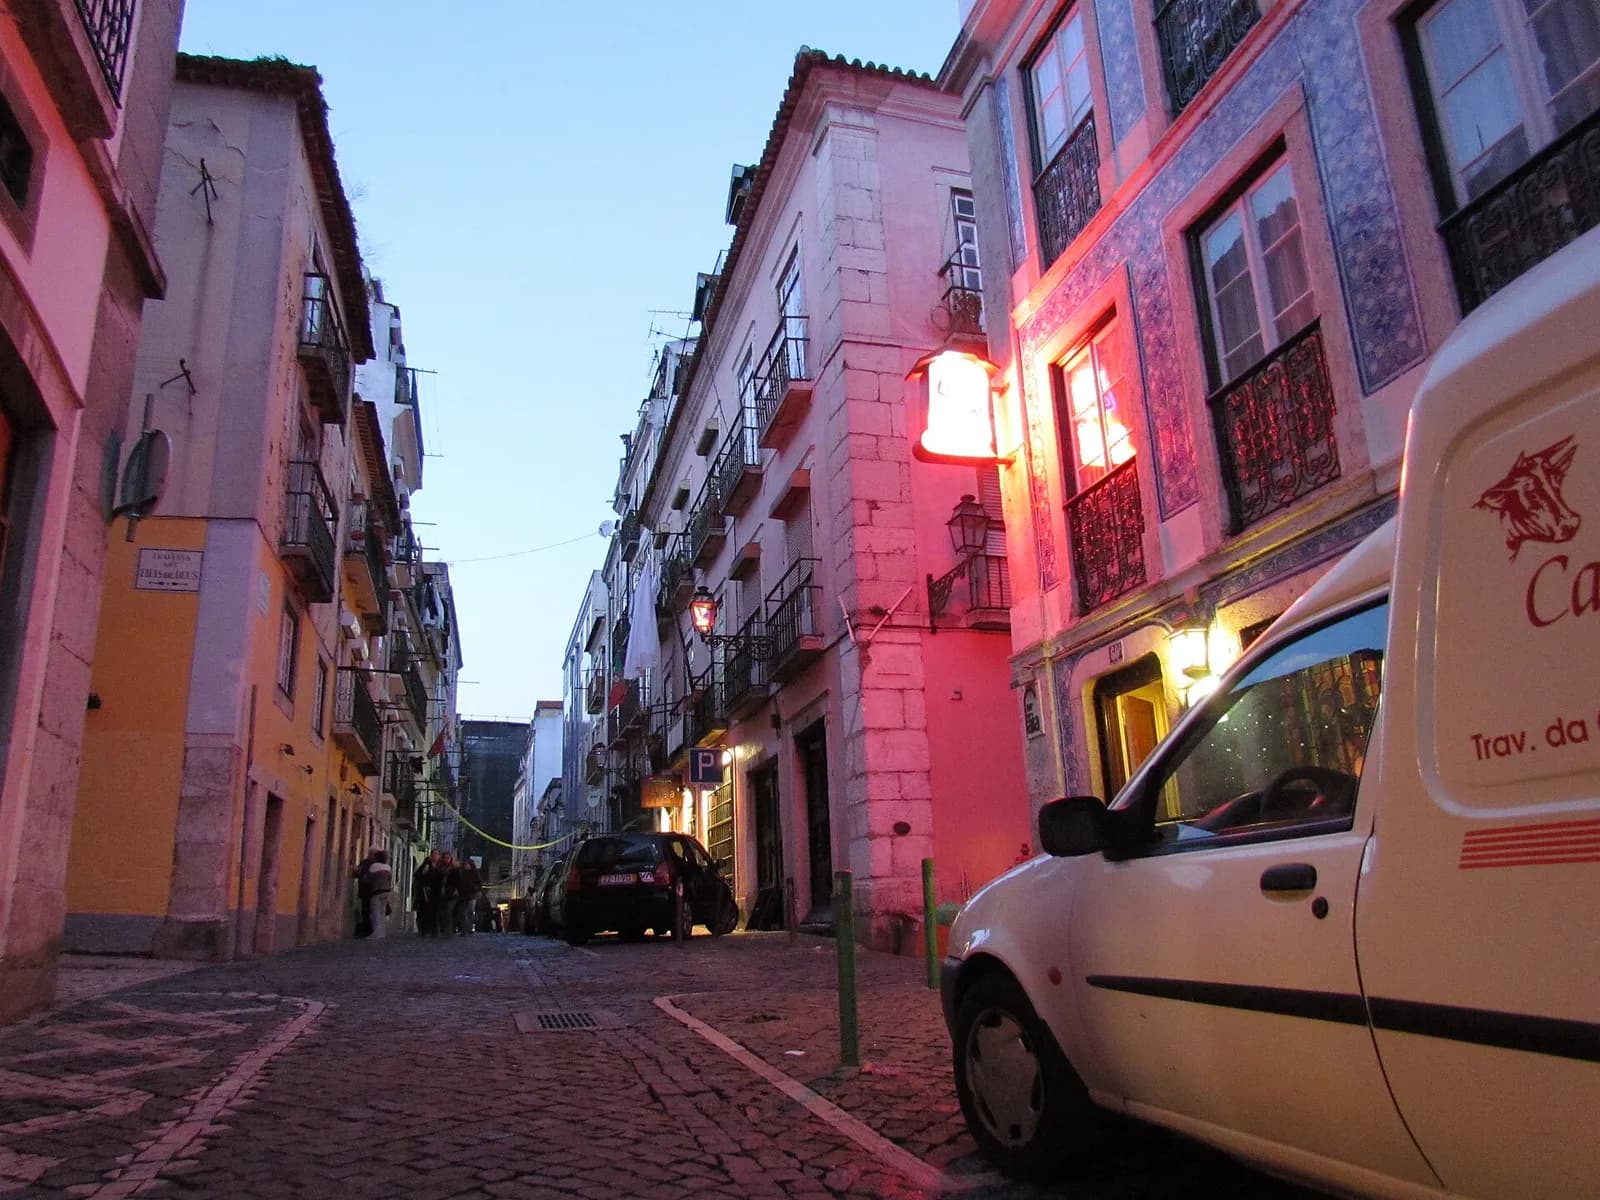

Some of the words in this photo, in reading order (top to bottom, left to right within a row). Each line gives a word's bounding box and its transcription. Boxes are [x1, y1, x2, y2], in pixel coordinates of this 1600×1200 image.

[152, 551, 192, 560] TRAVESSA
[1470, 731, 1536, 760] Trav.
[1545, 717, 1589, 748] da
[698, 752, 715, 780] P
